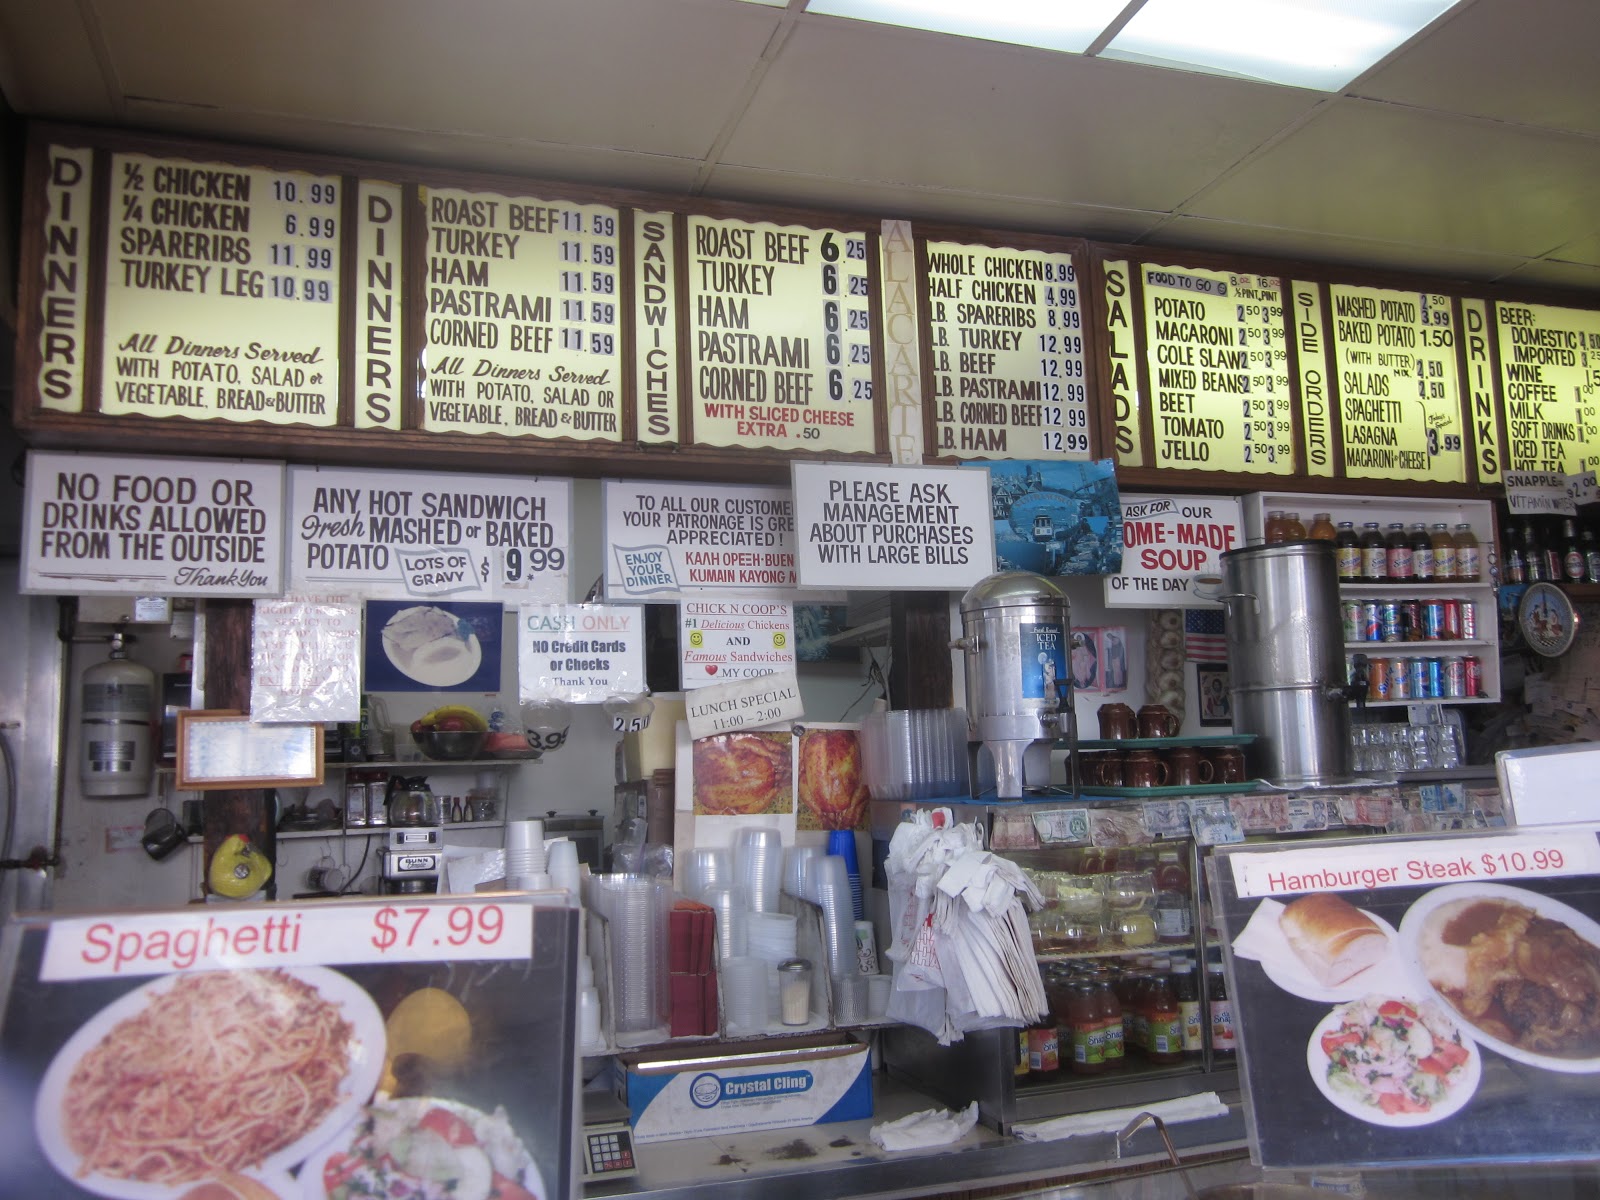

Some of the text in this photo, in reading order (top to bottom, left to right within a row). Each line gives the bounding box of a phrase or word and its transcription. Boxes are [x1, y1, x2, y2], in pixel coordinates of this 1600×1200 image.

[154, 166, 335, 205] CHICKEN 10.99
[151, 197, 335, 238] CHICKEN 6.99
[432, 197, 614, 236] ROAST BEEF 11.59
[120, 227, 331, 268] SPARERIBS 11.99
[433, 227, 519, 259] TURKEY
[696, 225, 809, 264] ROAST BEEF
[431, 257, 488, 287] HAM
[697, 260, 775, 296] TURKEY
[928, 253, 1075, 282] WHOLE CHICKEN 8.99
[120, 259, 329, 301] TURKEY LEG 10.99
[1148, 272, 1211, 291] FOOD TO GO
[972, 280, 1076, 307] CHICKEN 4.99
[431, 288, 614, 324] PASTRAMI 11.59
[698, 295, 749, 329] HAM
[957, 304, 1079, 330] SPARERIBS 8.99
[1155, 297, 1205, 320] POTATO
[1336, 295, 1415, 323] MASHED POTATO
[430, 318, 614, 354] CORNED BEEF 11.59
[959, 328, 1081, 354] TURKEY 12.99
[1156, 320, 1233, 346] MACARONI
[1338, 320, 1453, 348] BAKED POTATO 1.50
[1512, 327, 1577, 349] DOMESTIC
[119, 333, 324, 365] All Dinners Served
[699, 330, 809, 369] PASTRAMI
[1157, 345, 1241, 370] COLE SLAW
[1514, 346, 1576, 366] IMPORTED
[116, 357, 304, 387] WITH SALAD
[960, 352, 995, 374] BEEF
[1506, 364, 1542, 383] WINE
[700, 366, 813, 405] CORNED BEEF
[960, 377, 1041, 400] PASTRAMI
[1159, 368, 1245, 394] MIXED BEANS
[1344, 371, 1389, 396] SALADS
[1508, 383, 1557, 402] COFFEE
[961, 402, 1042, 426] CORNED BEEF
[1160, 392, 1195, 413] BEET
[1345, 399, 1402, 423] SPAGHETTI
[1510, 402, 1543, 421] MILK
[705, 403, 854, 426] WITH SLICED CHEESE
[737, 422, 787, 438] EXTRA
[1161, 416, 1224, 438] TOMATO
[1346, 425, 1398, 446] LASAGNA
[1511, 421, 1575, 441] SOFT DRINKS
[961, 428, 1007, 451] HAM
[1162, 440, 1209, 461] JELLO
[1513, 440, 1566, 460] ICED TEA
[58, 472, 254, 506] NO FOOD OR
[829, 480, 951, 504] PLEASE ASK
[313, 488, 546, 521] ANY HOT SANDWICH
[636, 495, 719, 513] TO ALL OUR
[824, 503, 959, 524] MANAGEMENT
[1126, 501, 1212, 518] ASK FOR OUR
[43, 502, 266, 534] DRINKS ALLOWED
[301, 510, 553, 548] Fresh MASHED or BAKED
[623, 511, 744, 530] YOUR PATRONAGE
[810, 523, 973, 544] ABOUT PURCHASES
[1123, 522, 1235, 551] OME-MADE
[41, 531, 266, 563] FROM THE OUTSIDE
[307, 543, 388, 570] POTATO
[625, 551, 662, 566] ENJOY
[818, 544, 968, 564] WITH LARGE BILLS
[405, 556, 466, 571] LOTS OF
[628, 563, 664, 575] YOUR
[1141, 549, 1207, 571] SOUP
[174, 567, 268, 587] Thank You
[412, 571, 465, 586] GRAVY
[626, 574, 673, 587] DINNER
[690, 569, 785, 583] KUMAIN KAYONG
[1112, 577, 1189, 591] OF THE DAY
[687, 603, 726, 614] CHICK
[528, 615, 630, 631] CASH ONLY
[701, 619, 790, 630] Delicious Chickens
[551, 640, 626, 654] Credit Cards
[726, 637, 750, 646] AND
[1036, 633, 1056, 641] ICED
[1038, 642, 1055, 650] TEA
[566, 658, 610, 671] Checks
[684, 651, 792, 662] Famous Sandwiches
[552, 677, 608, 686] Thank You
[690, 688, 796, 718] LUNCH SPECIAL
[1268, 849, 1564, 892] Hamburger Steak $10.99
[82, 905, 504, 972] Spaghetti $7.99
[725, 1076, 807, 1095] Crystal Cling
